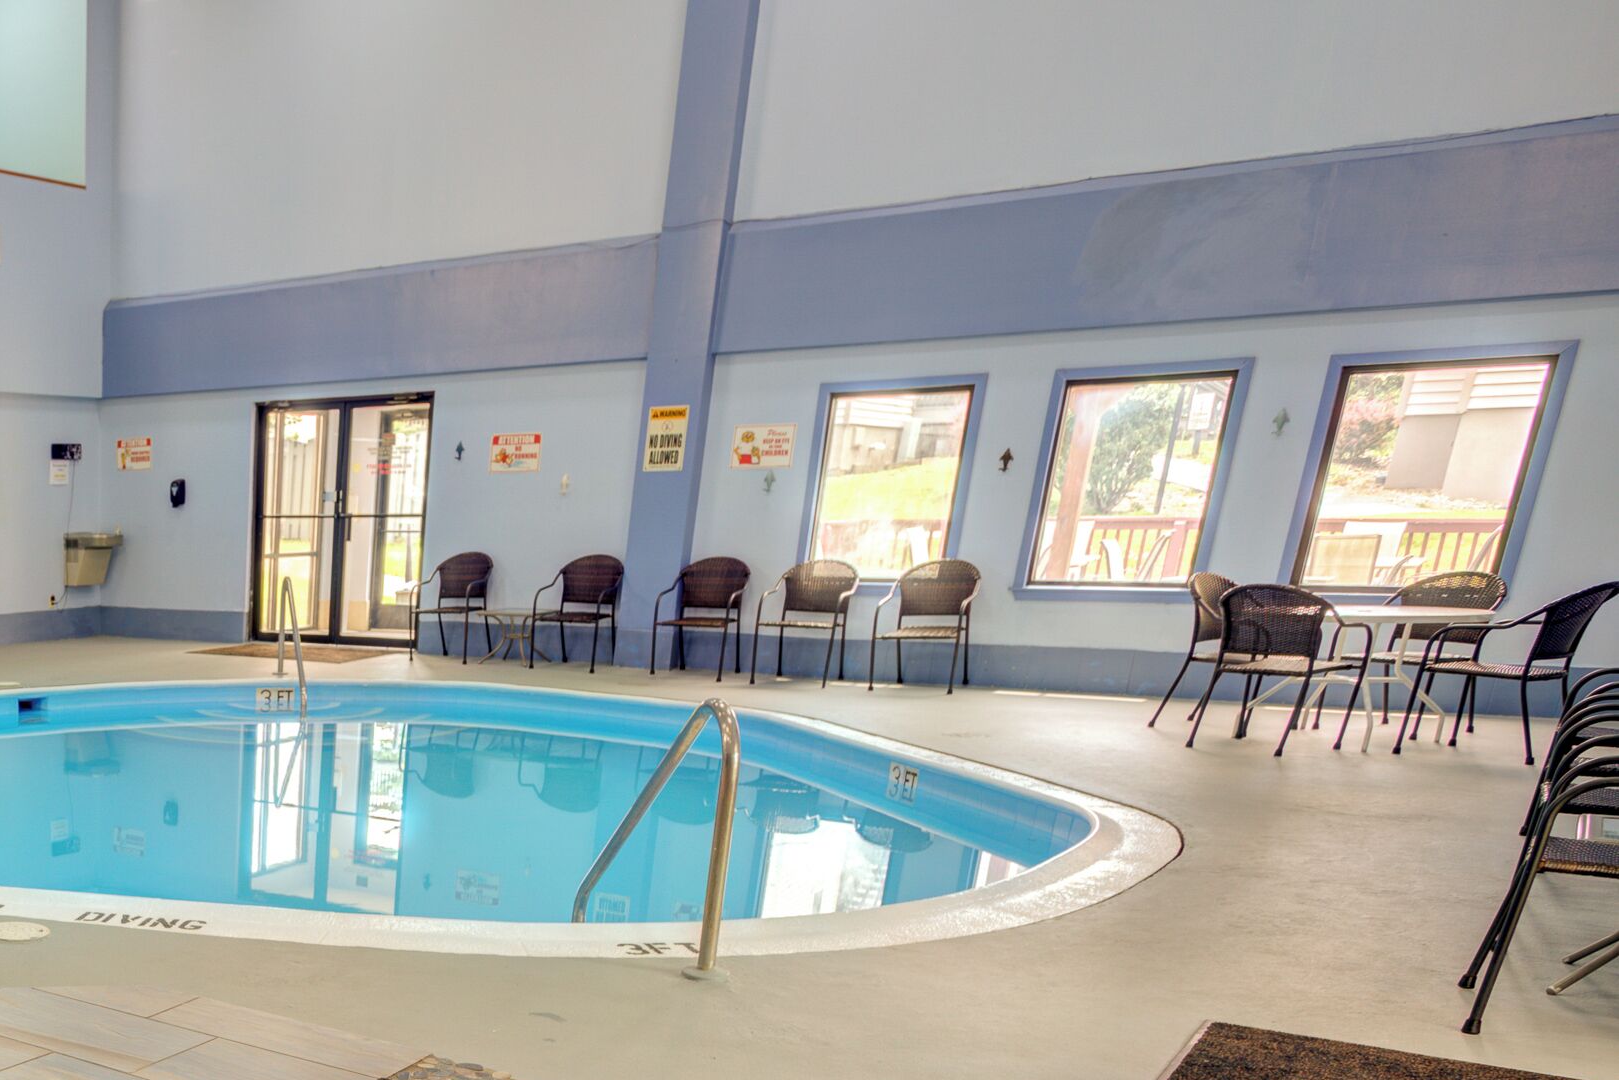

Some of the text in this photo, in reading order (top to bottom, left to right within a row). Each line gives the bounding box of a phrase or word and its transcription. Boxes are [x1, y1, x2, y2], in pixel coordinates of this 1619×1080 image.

[659, 409, 686, 417] WARNING
[649, 433, 683, 449] NO DIVING
[649, 450, 679, 465] ALLOWED
[261, 689, 294, 705] 3 FT
[903, 770, 918, 790] FT
[74, 911, 207, 931] DIVING
